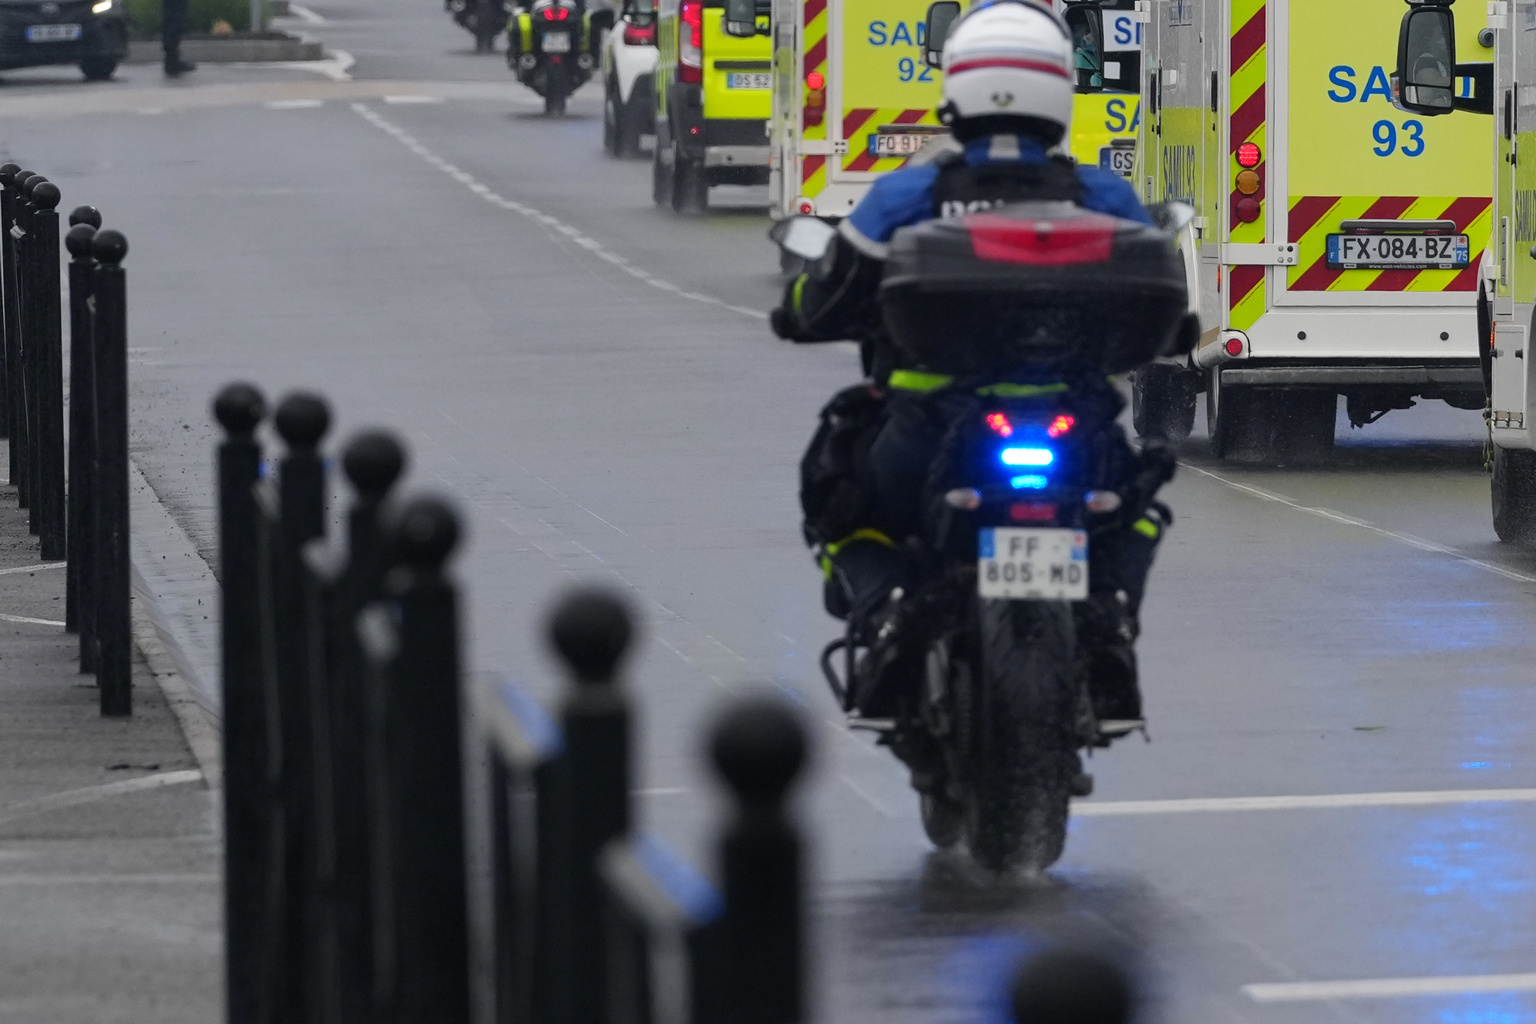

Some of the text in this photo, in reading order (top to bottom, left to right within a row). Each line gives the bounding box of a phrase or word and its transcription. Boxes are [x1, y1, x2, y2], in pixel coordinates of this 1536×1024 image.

[898, 57, 933, 82] 92
[1372, 119, 1425, 158] 93
[1515, 189, 1532, 242] SAMU
[1343, 238, 1452, 259] FX-084-BZ
[1456, 250, 1468, 262] 75
